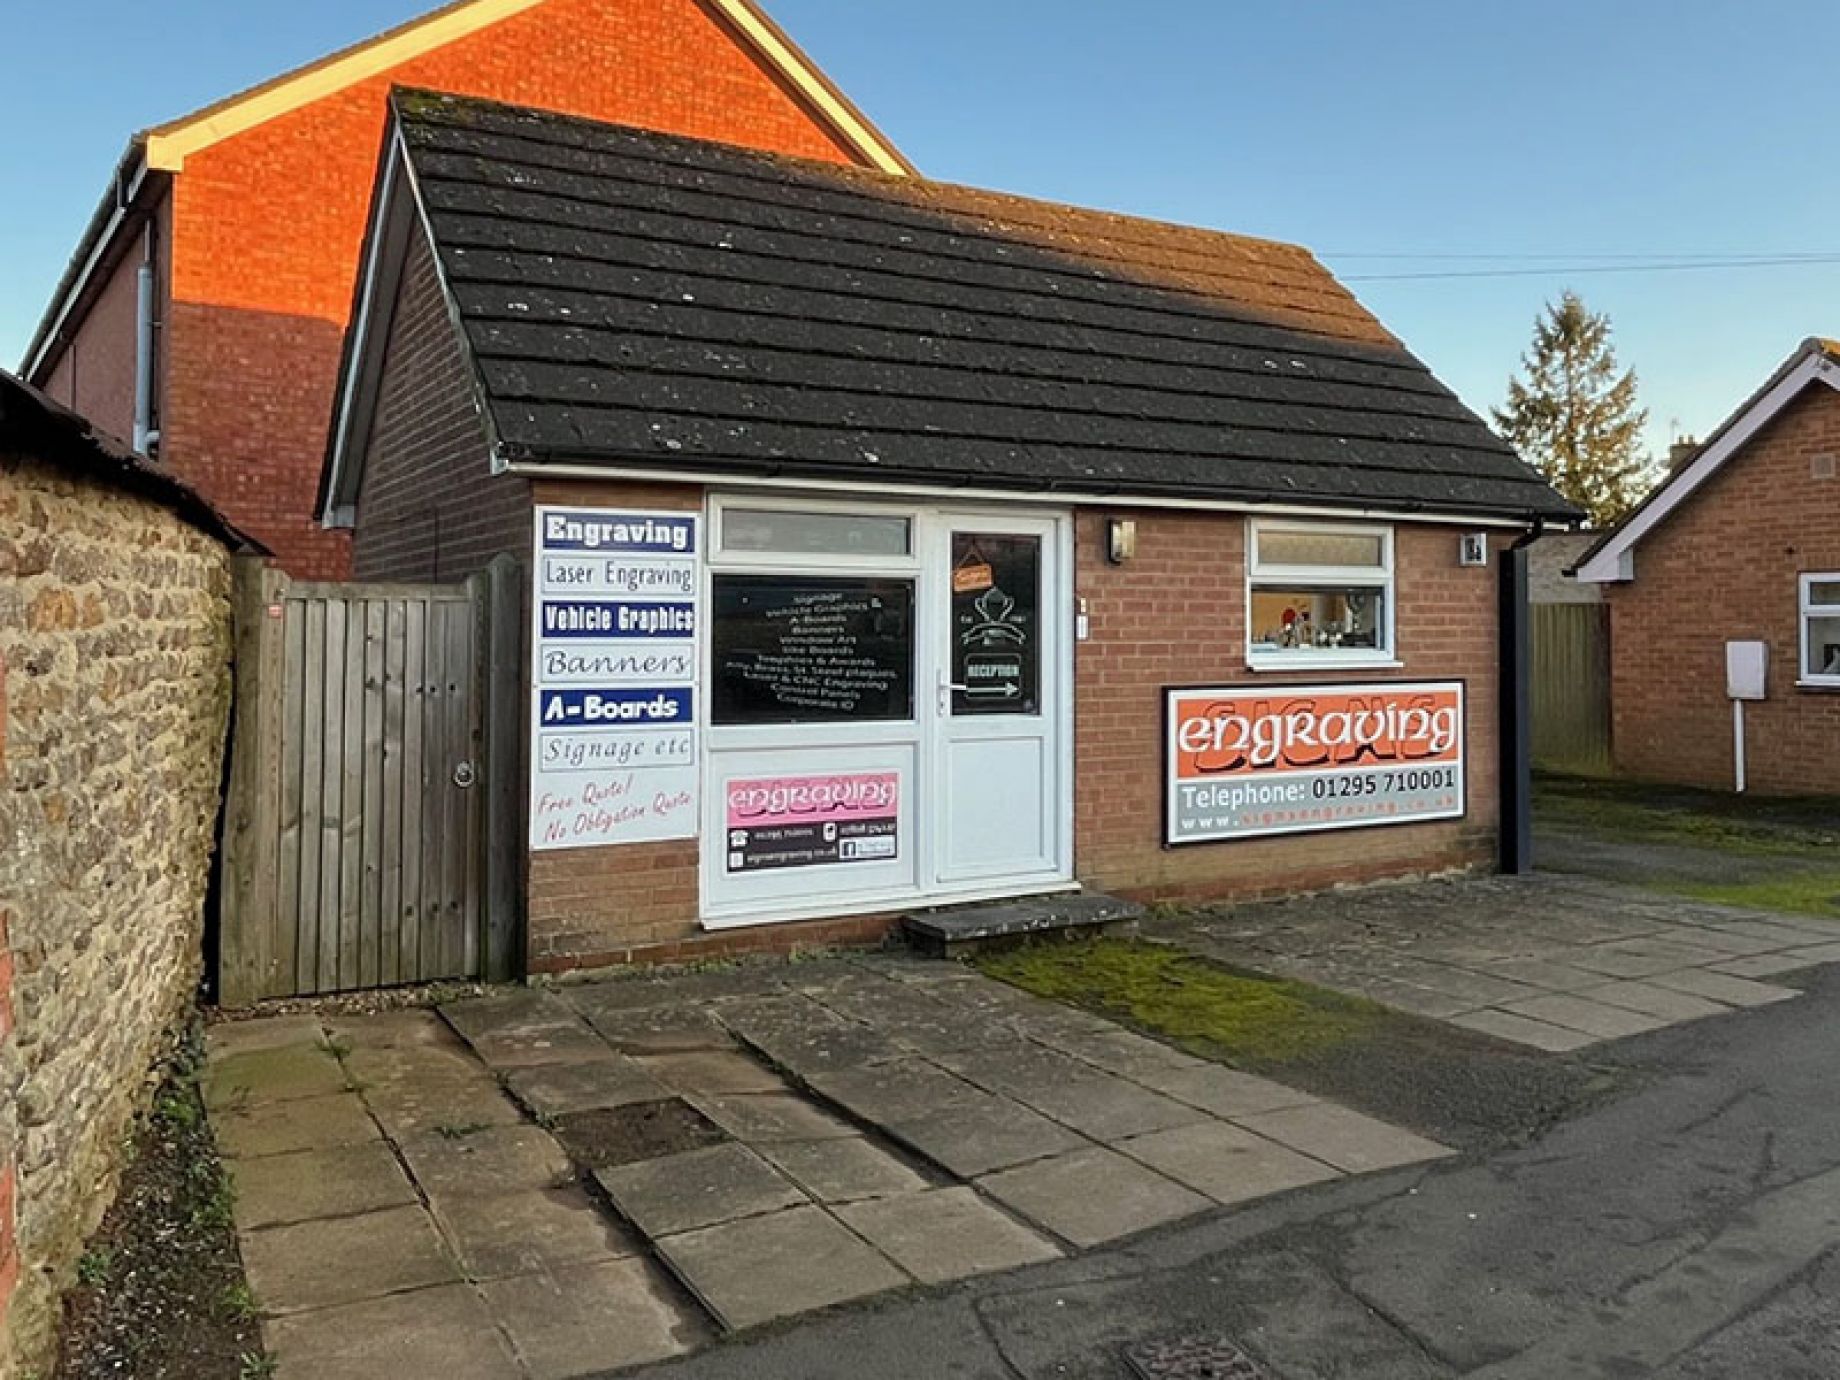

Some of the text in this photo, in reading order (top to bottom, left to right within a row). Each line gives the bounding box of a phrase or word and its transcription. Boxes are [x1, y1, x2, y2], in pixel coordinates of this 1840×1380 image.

[546, 515, 689, 550] Engraving
[546, 560, 691, 591] Laser Engraving
[545, 605, 693, 634] Vehicle Graphics
[545, 650, 690, 675] Banners
[544, 693, 680, 721] A-Boards
[1180, 703, 1456, 765] engraving
[544, 737, 689, 766] Signage etc
[538, 772, 634, 814] Free Quote!
[1182, 769, 1454, 811] Telephone: 01295 710001
[544, 790, 691, 842] No Obligation Quote
